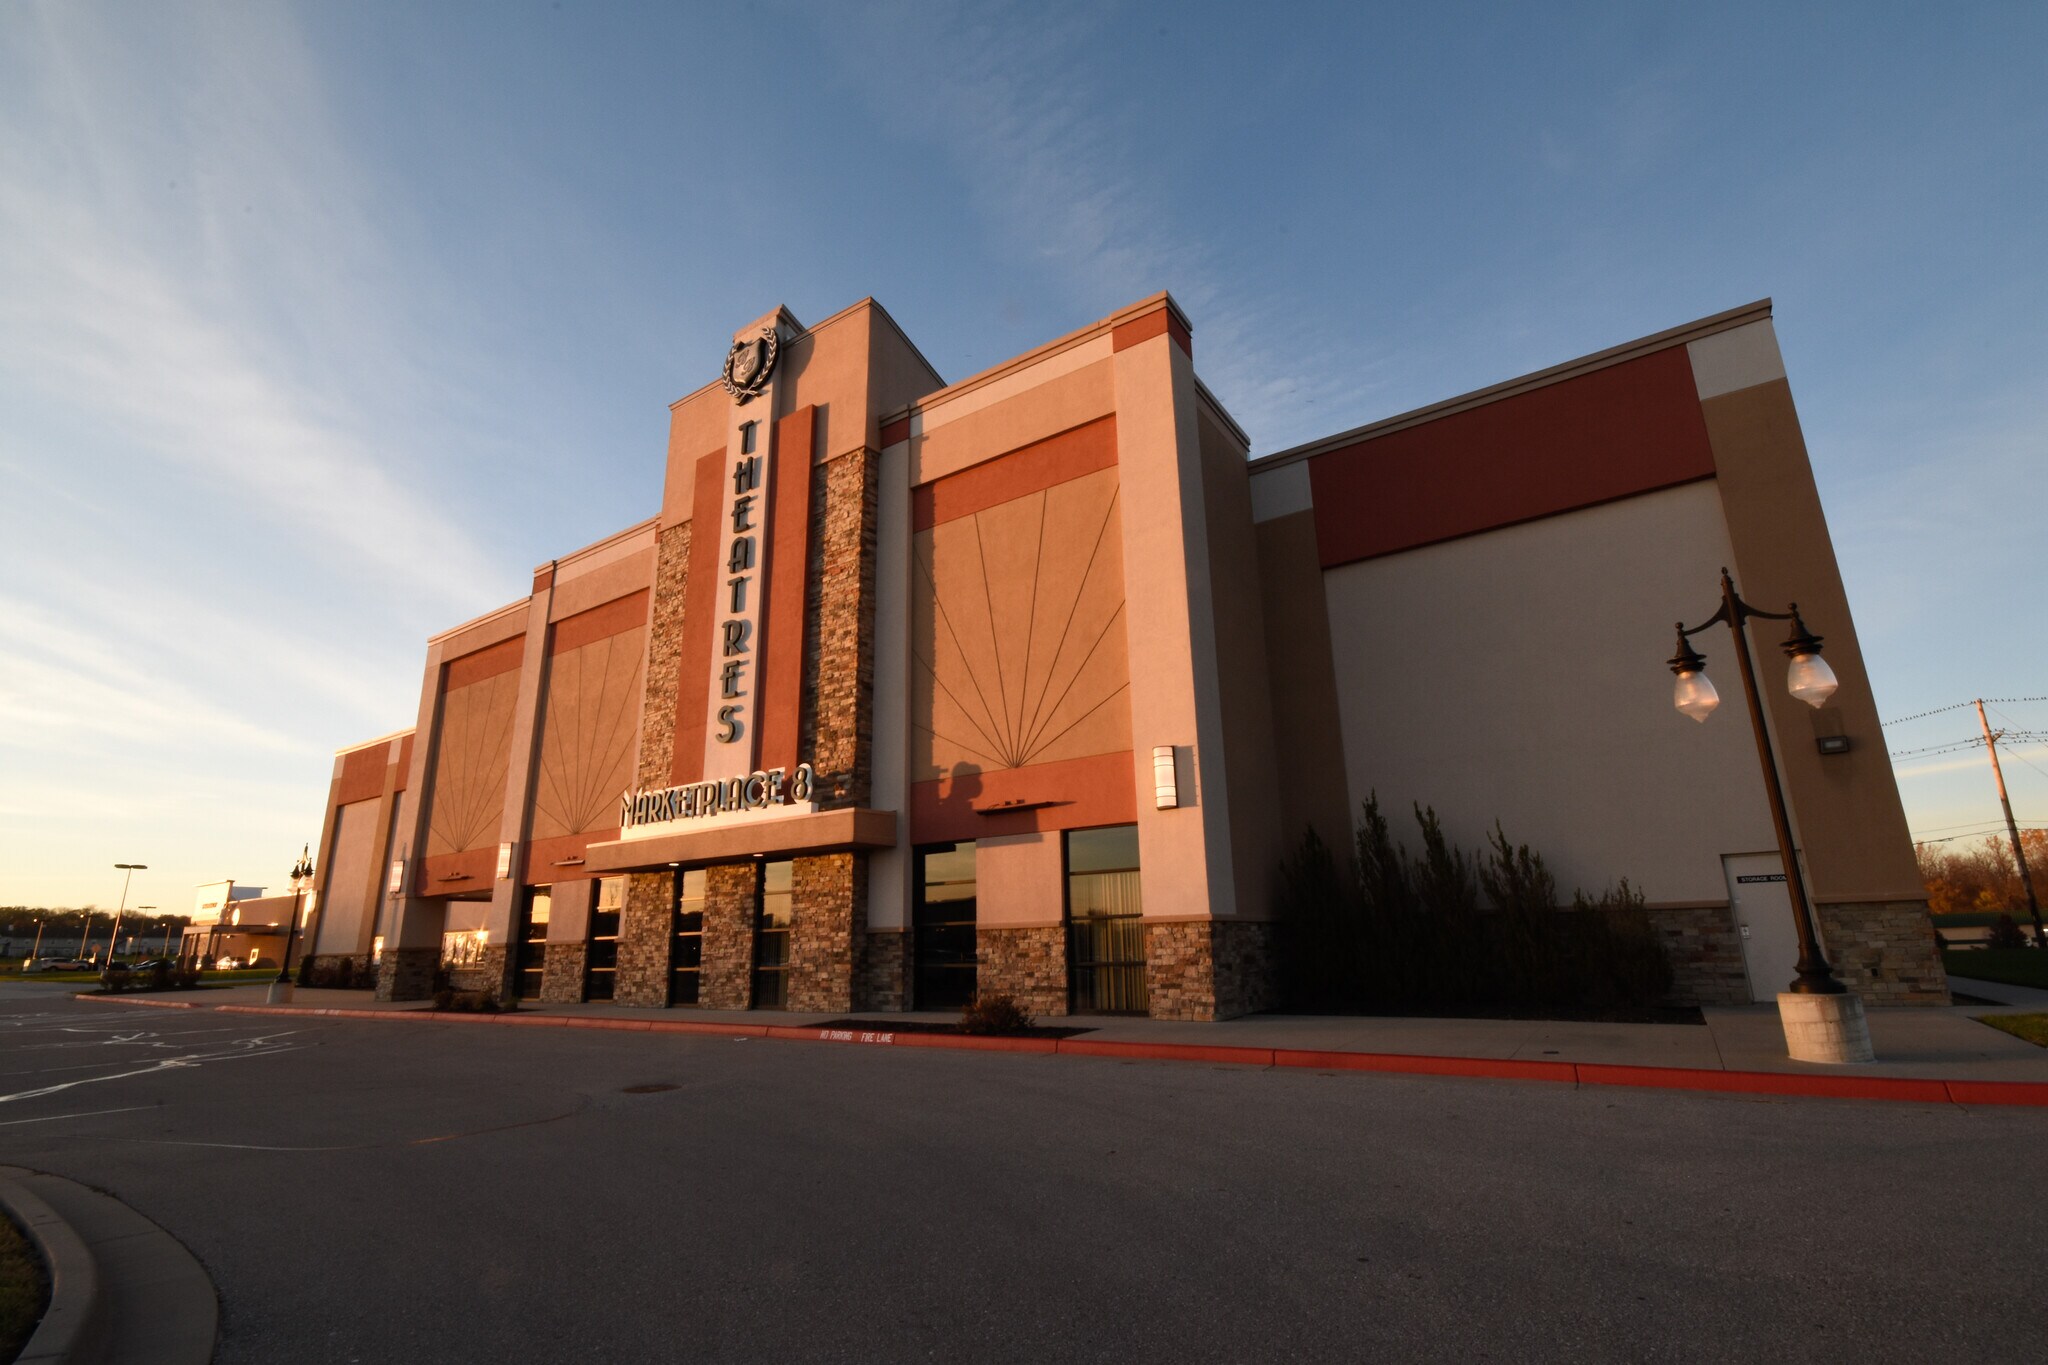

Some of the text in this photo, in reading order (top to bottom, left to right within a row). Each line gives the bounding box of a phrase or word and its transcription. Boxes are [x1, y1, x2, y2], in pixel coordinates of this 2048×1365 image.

[715, 419, 755, 743] THEATRES
[620, 767, 809, 828] MARKETPLACE 8
[820, 1030, 893, 1043] NO PARKING FIRE LANE
